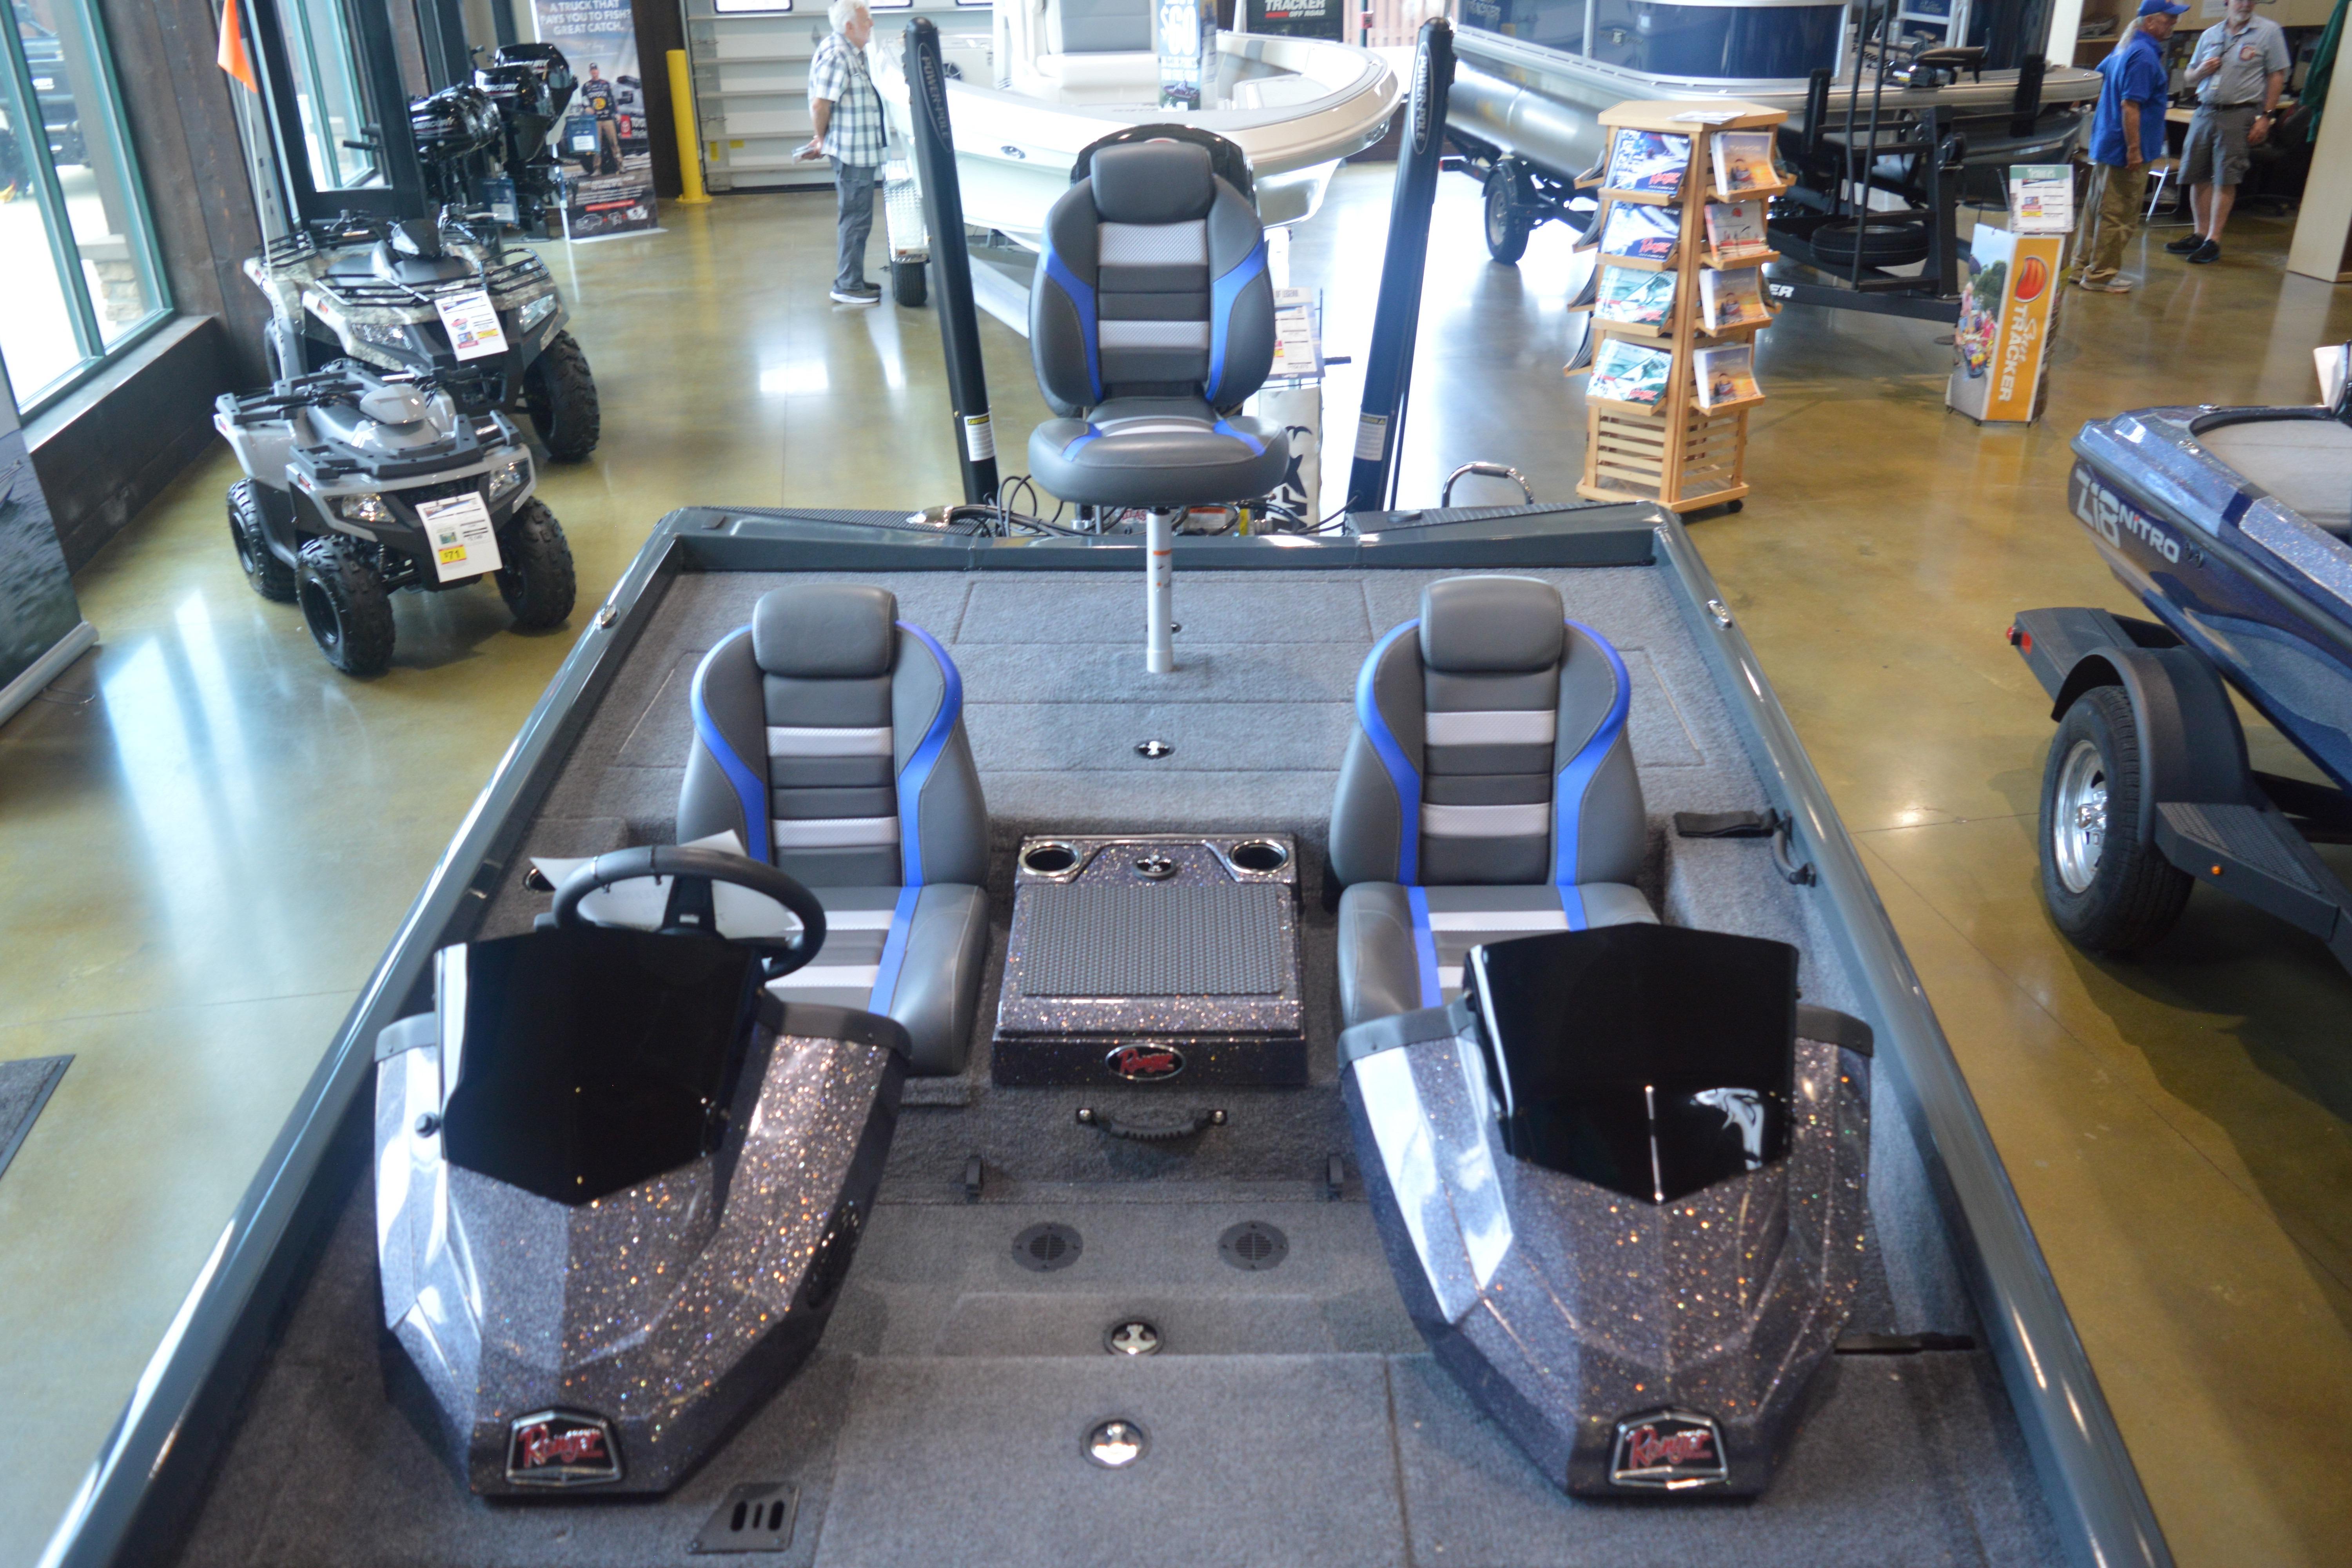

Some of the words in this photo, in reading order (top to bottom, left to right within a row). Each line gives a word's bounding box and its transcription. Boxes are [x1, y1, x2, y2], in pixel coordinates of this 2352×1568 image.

[550, 3, 558, 12] A
[558, 0, 591, 11] TRUCK
[592, 0, 619, 9] THAT
[1265, 0, 1326, 11] TRACKER
[540, 14, 564, 25] PAYS
[566, 12, 588, 22] YOU
[588, 11, 603, 21] TO
[604, 9, 632, 20] FISH?
[553, 24, 586, 35] GREAT
[1998, 305, 2028, 402] TRACKER
[2076, 467, 2121, 549] Z18
[445, 550, 461, 560] $71
